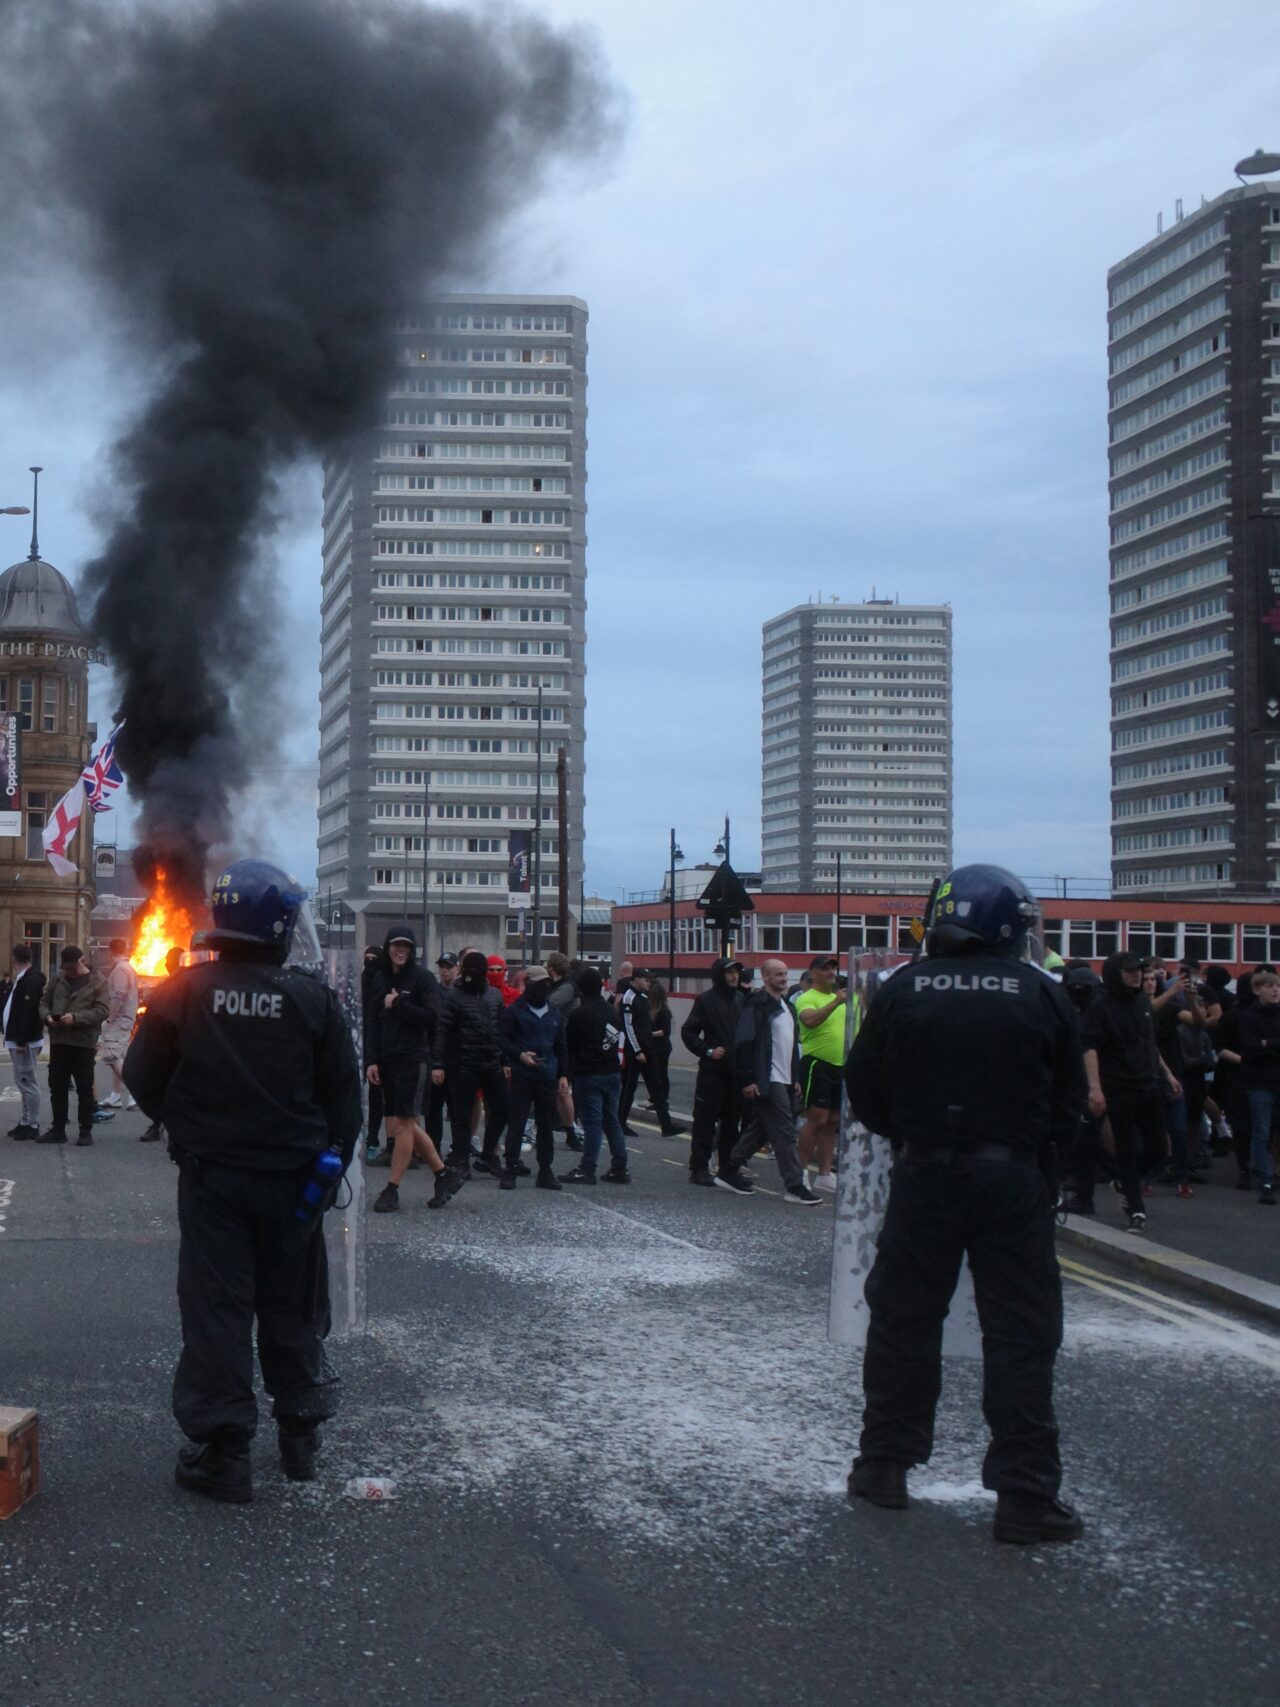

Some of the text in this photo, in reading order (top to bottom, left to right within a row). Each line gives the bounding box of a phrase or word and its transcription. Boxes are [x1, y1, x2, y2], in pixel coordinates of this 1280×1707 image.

[519, 855, 528, 883] Talent
[914, 974, 1020, 994] POLICE
[213, 989, 283, 1019] POLICE
